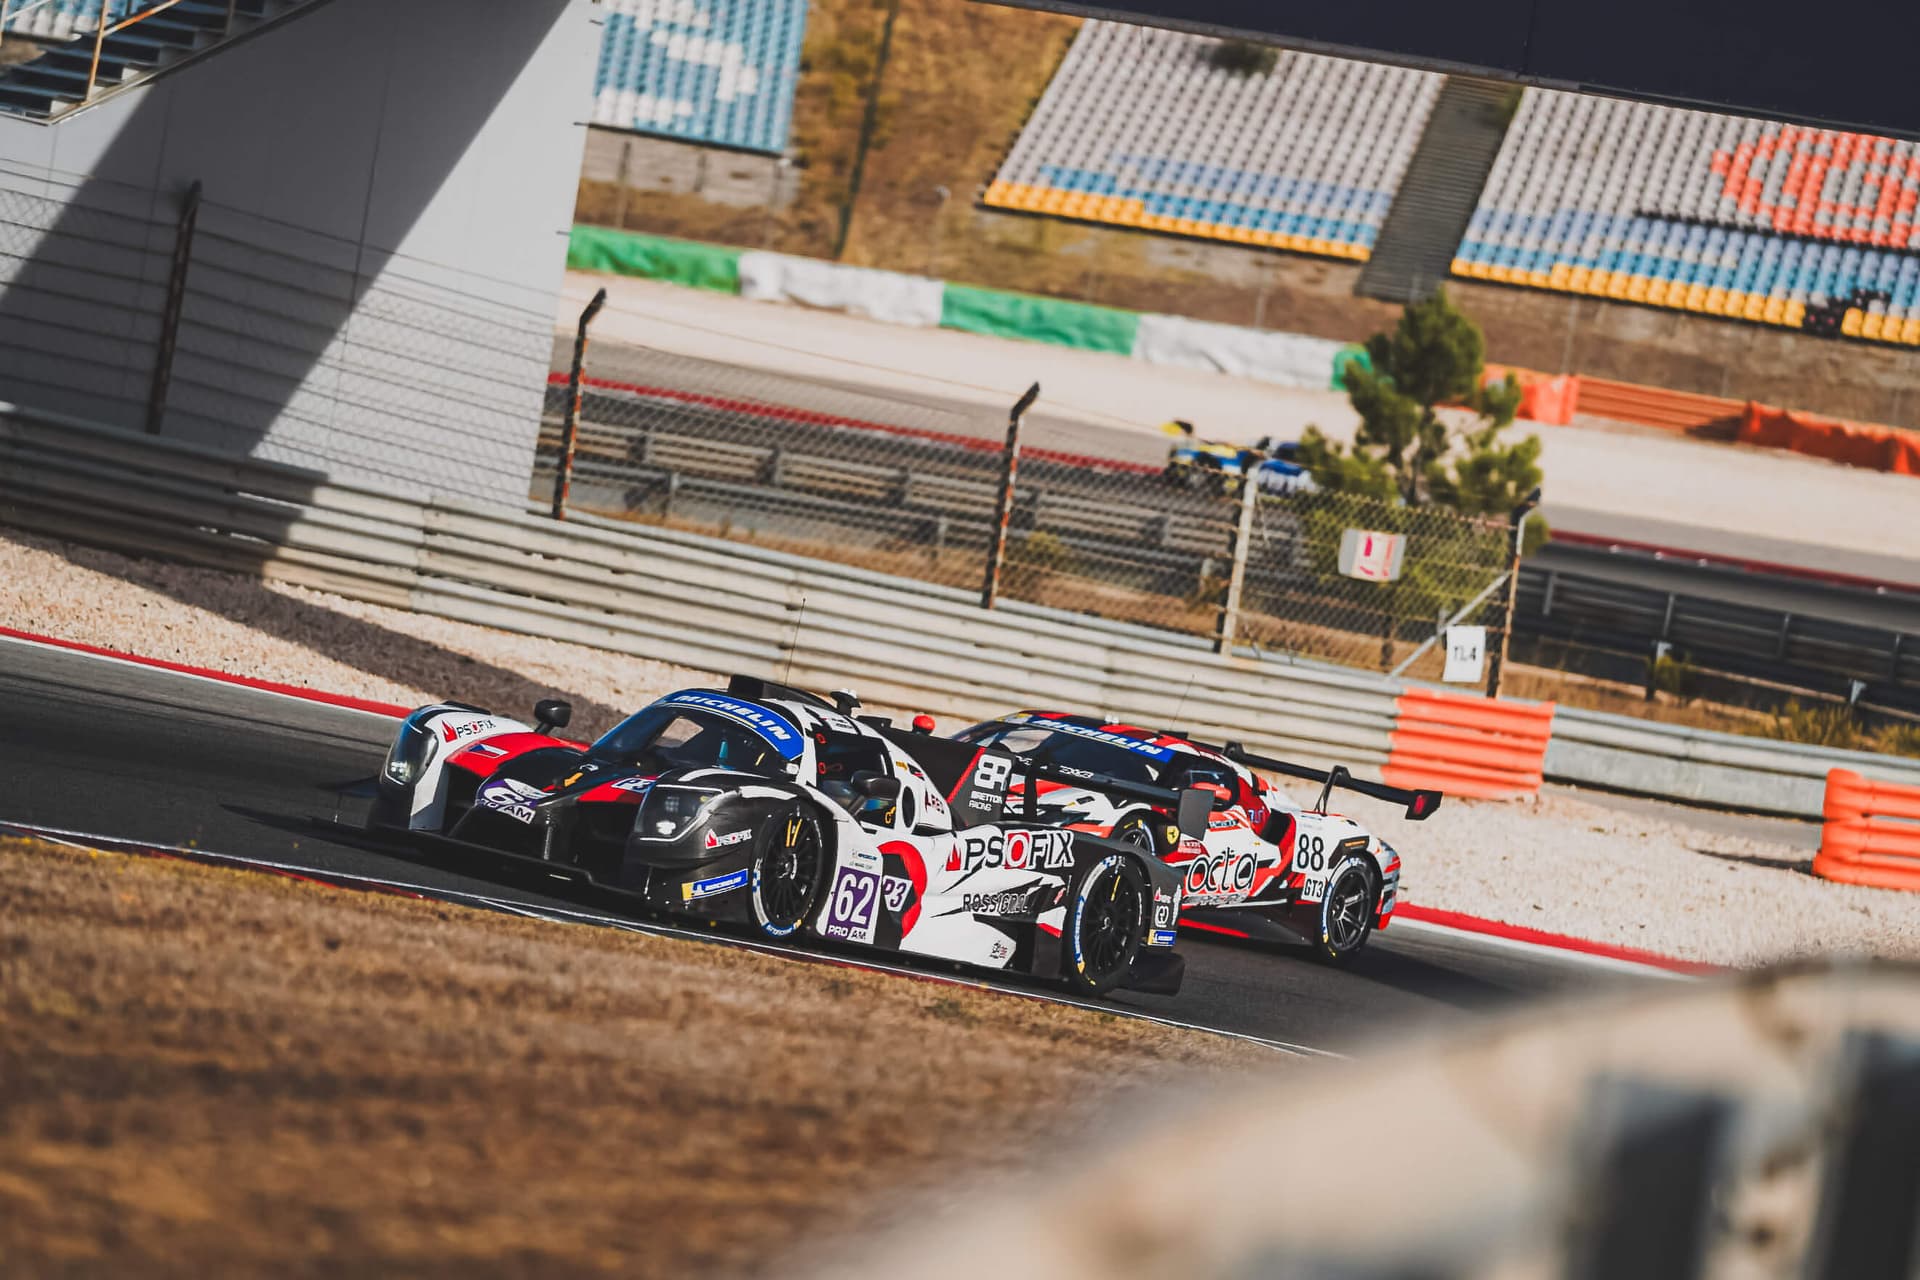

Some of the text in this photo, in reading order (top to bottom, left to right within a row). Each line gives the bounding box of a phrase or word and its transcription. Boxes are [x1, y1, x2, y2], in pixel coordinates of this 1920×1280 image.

[673, 695, 792, 740] MICHELIN
[1032, 719, 1164, 755] MICHELIN
[503, 805, 532, 821] AM
[1187, 846, 1258, 893] octa
[1297, 833, 1324, 871] 88
[835, 873, 874, 925] 62
[883, 878, 908, 908] P3
[1304, 878, 1324, 898] GT3
[827, 924, 849, 937] PRO
